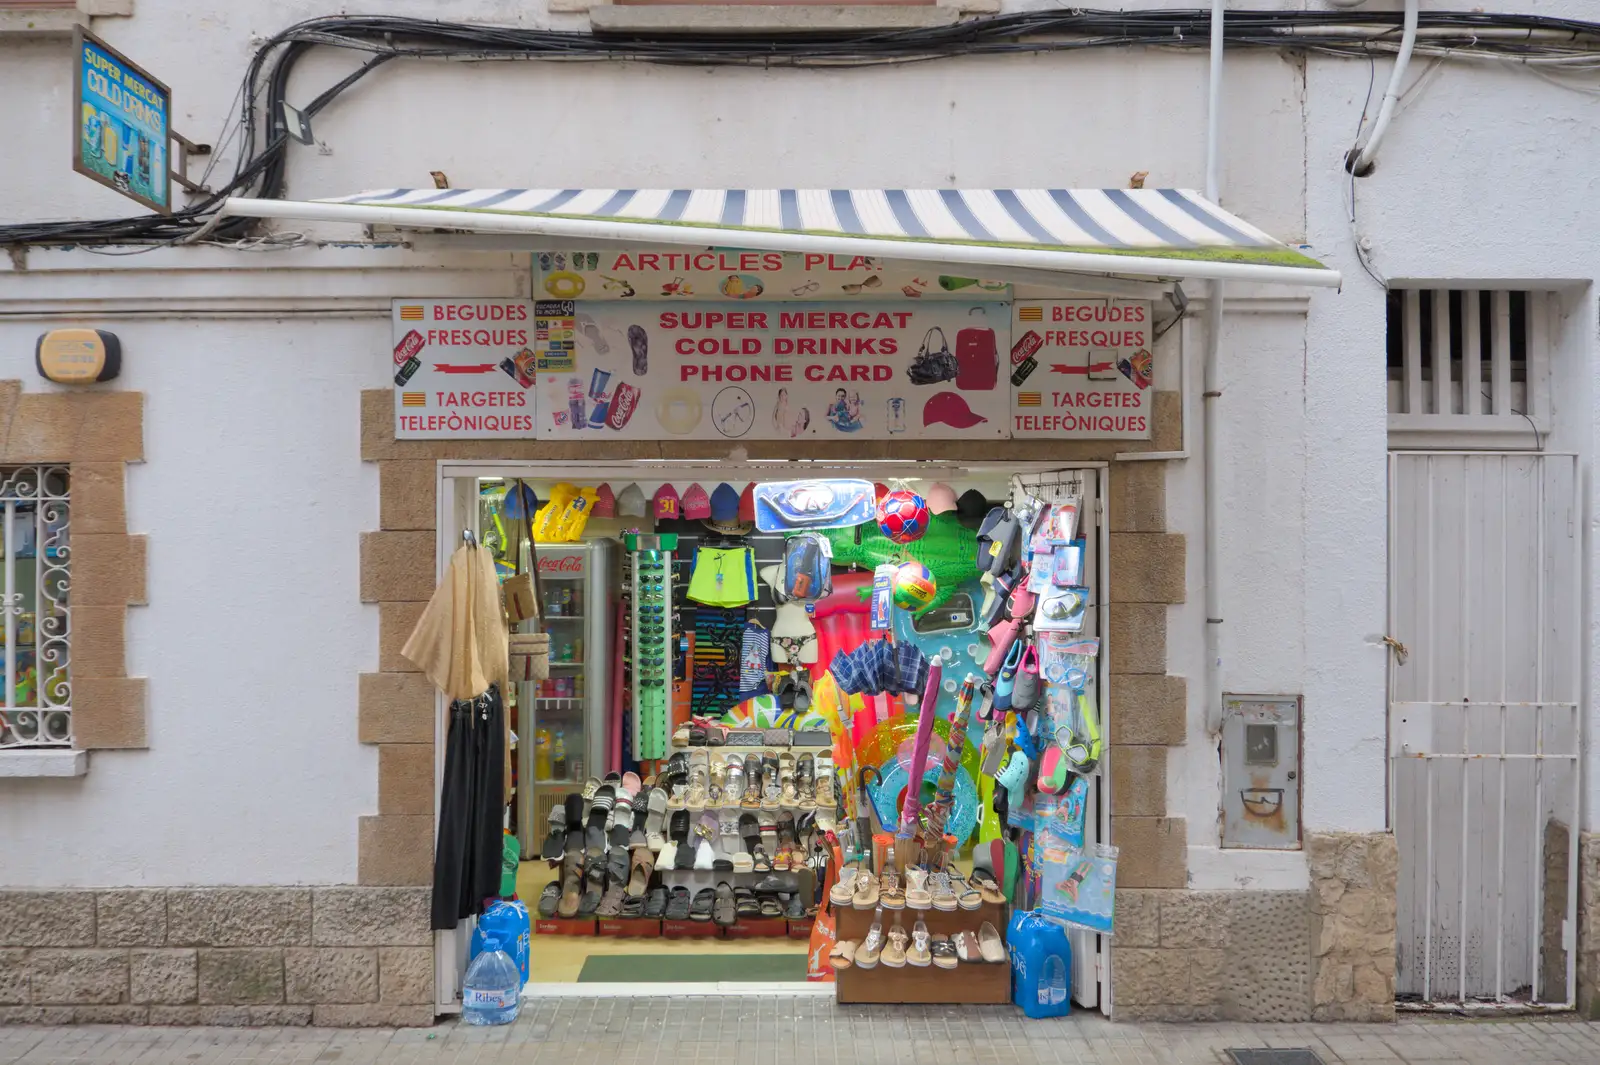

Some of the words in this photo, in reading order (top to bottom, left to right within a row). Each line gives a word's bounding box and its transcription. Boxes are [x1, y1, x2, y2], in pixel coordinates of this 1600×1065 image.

[85, 48, 121, 83] SUPER
[124, 73, 164, 111] MERCAT
[87, 70, 121, 106] COLD
[124, 92, 160, 132] DRINKS
[612, 253, 782, 272] ARTICLES
[433, 304, 527, 321] BEGUDES
[659, 311, 768, 330] SUPER
[779, 311, 913, 330] MERCAT
[1051, 305, 1145, 322] BEGUDES
[427, 329, 527, 346] FRESQUES
[675, 337, 762, 356] COLD
[773, 337, 899, 356] DRINKS
[1045, 329, 1145, 348] FRESQUES
[679, 364, 793, 383] PHONE
[804, 364, 893, 383] CARD
[437, 391, 526, 407] TARGETES
[1052, 391, 1141, 408] TARGETES
[400, 411, 532, 431] TELEFÒNIQUES
[1015, 412, 1146, 432] TELEFÒNIQUES
[475, 991, 502, 1003] Ribes
